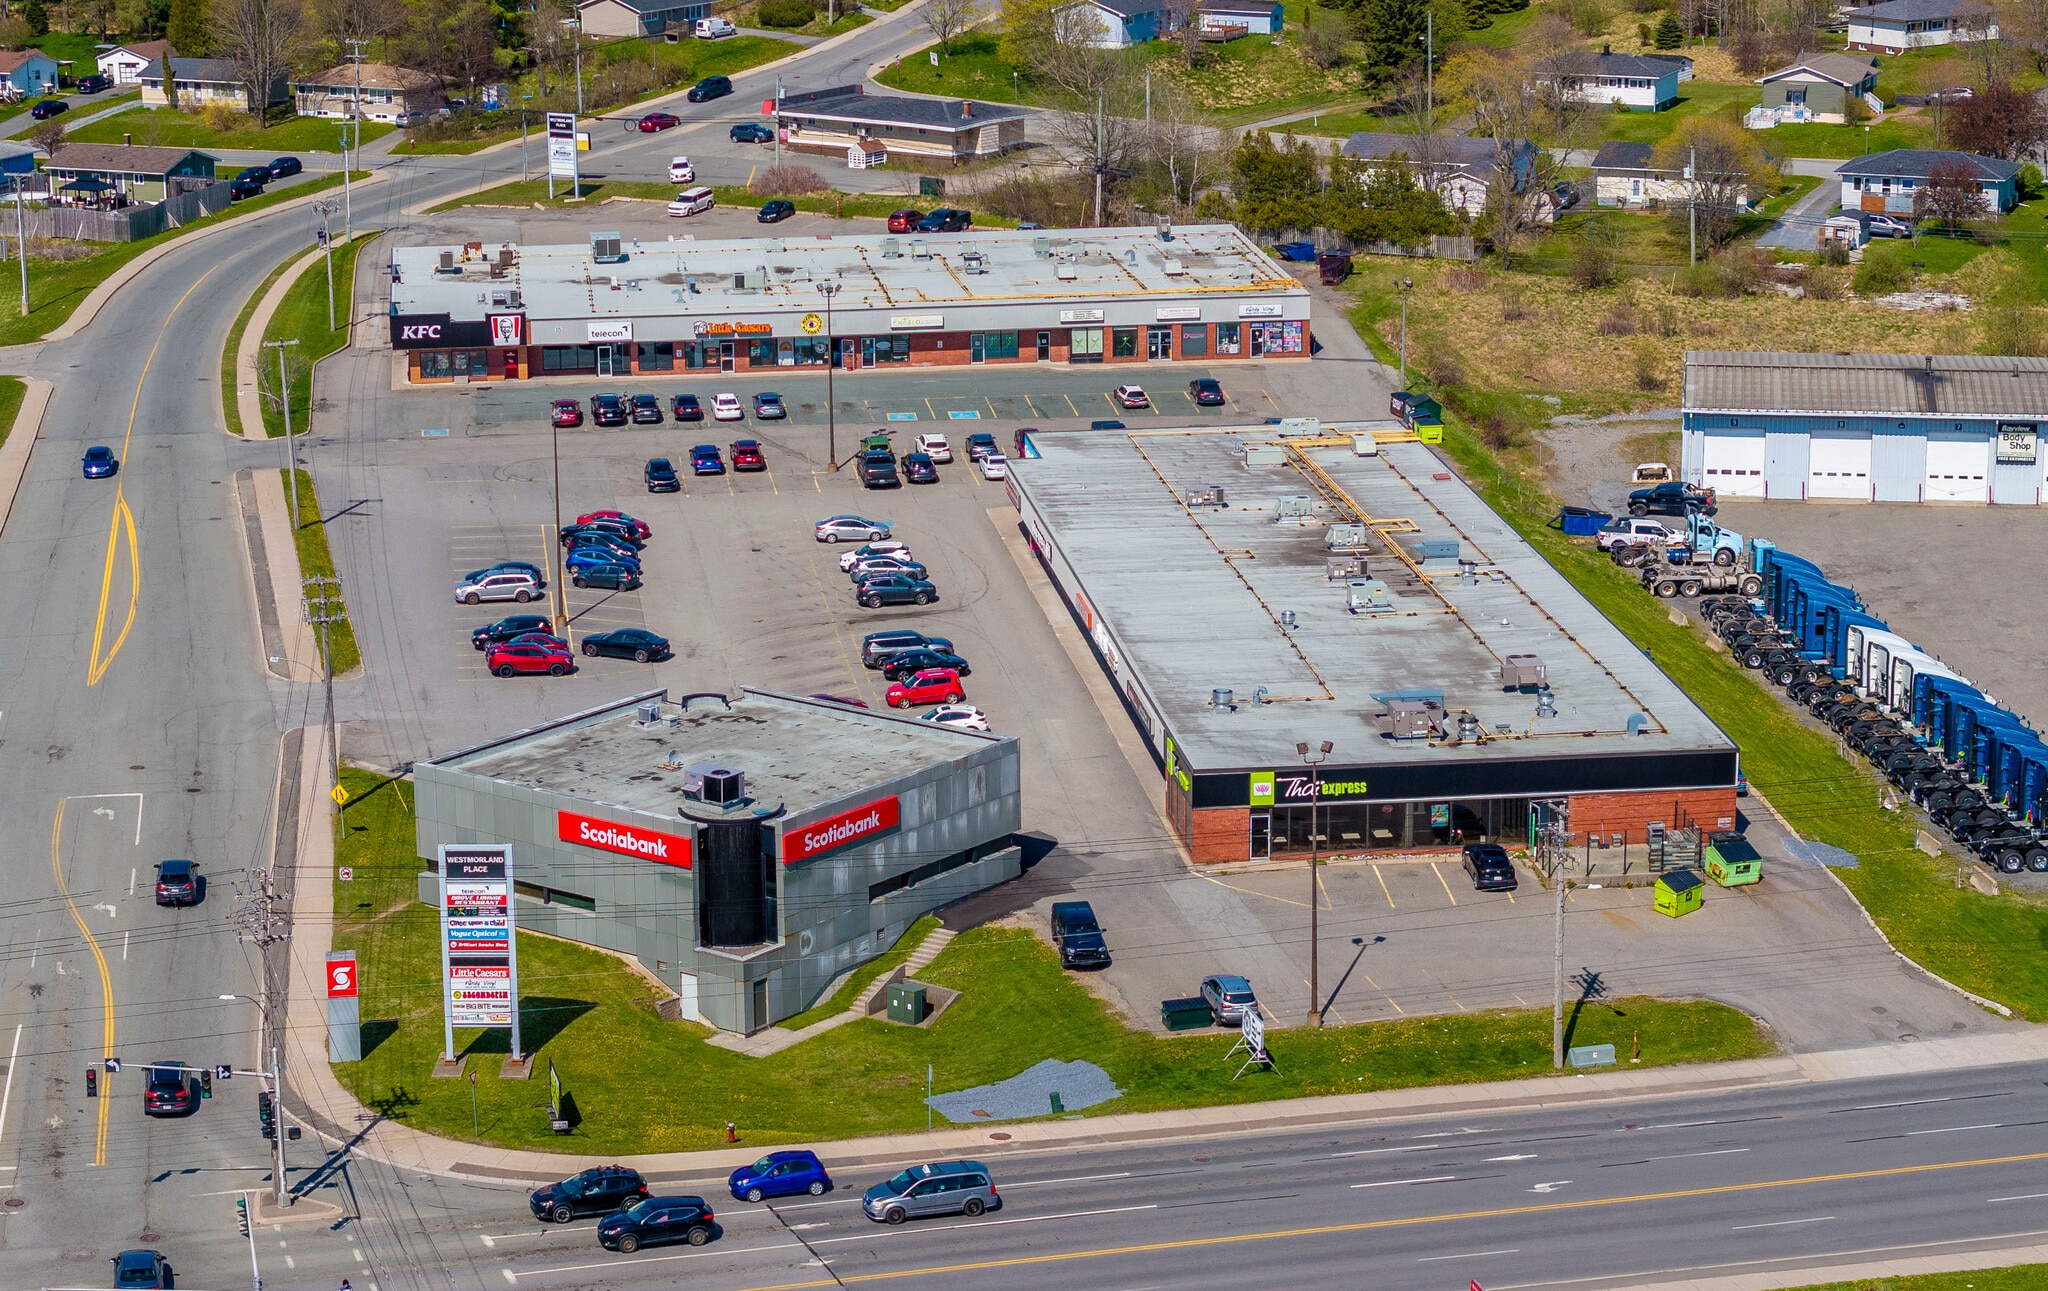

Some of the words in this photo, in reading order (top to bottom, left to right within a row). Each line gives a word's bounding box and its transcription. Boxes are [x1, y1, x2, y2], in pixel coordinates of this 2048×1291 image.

[401, 325, 441, 340] KFC
[708, 322, 733, 334] Little
[734, 321, 771, 333] Caesars
[591, 330, 623, 338] telecon
[2003, 433, 2026, 442] Body
[2009, 441, 2031, 451] Shop
[1321, 781, 1367, 796] express
[804, 810, 880, 851] Scotiabank
[580, 821, 668, 858] Scotiabank
[451, 930, 471, 938] Vogue
[472, 930, 498, 938] Optical
[452, 968, 475, 977] Little
[475, 968, 507, 977] Caesars
